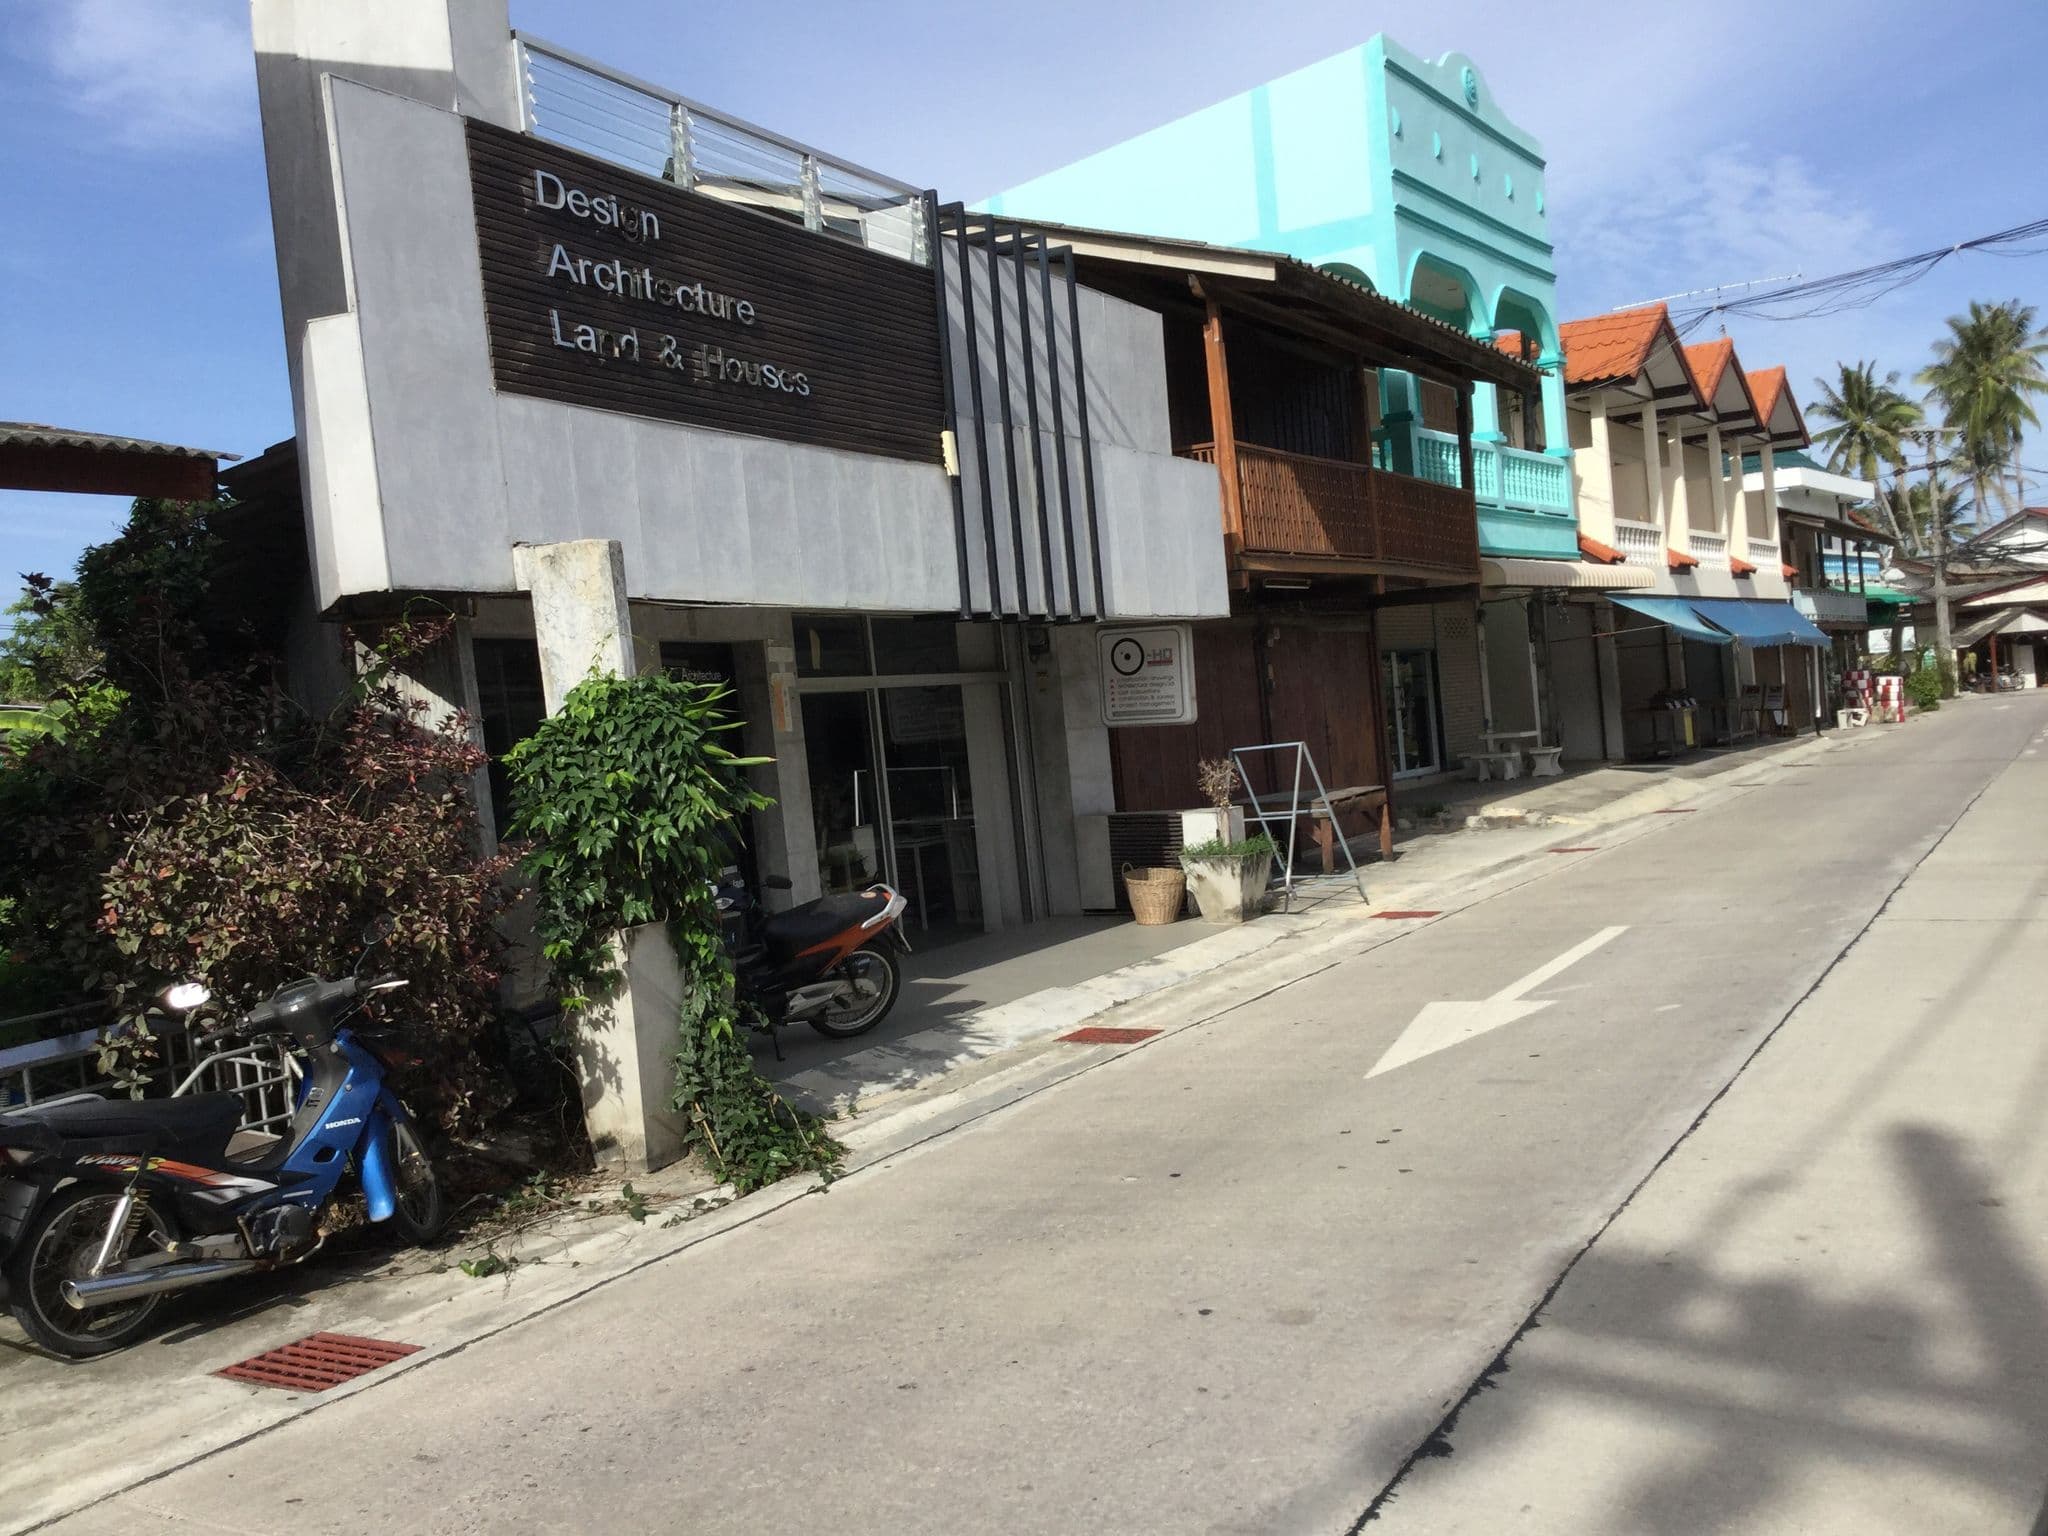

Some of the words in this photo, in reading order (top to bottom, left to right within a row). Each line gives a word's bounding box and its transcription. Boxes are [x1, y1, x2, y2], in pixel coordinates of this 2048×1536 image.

[534, 169, 661, 242] Design
[547, 243, 756, 325] Architecture
[551, 308, 640, 362] Land
[656, 334, 685, 370] &
[699, 344, 811, 397] Houses
[325, 1117, 361, 1130] HONDA
